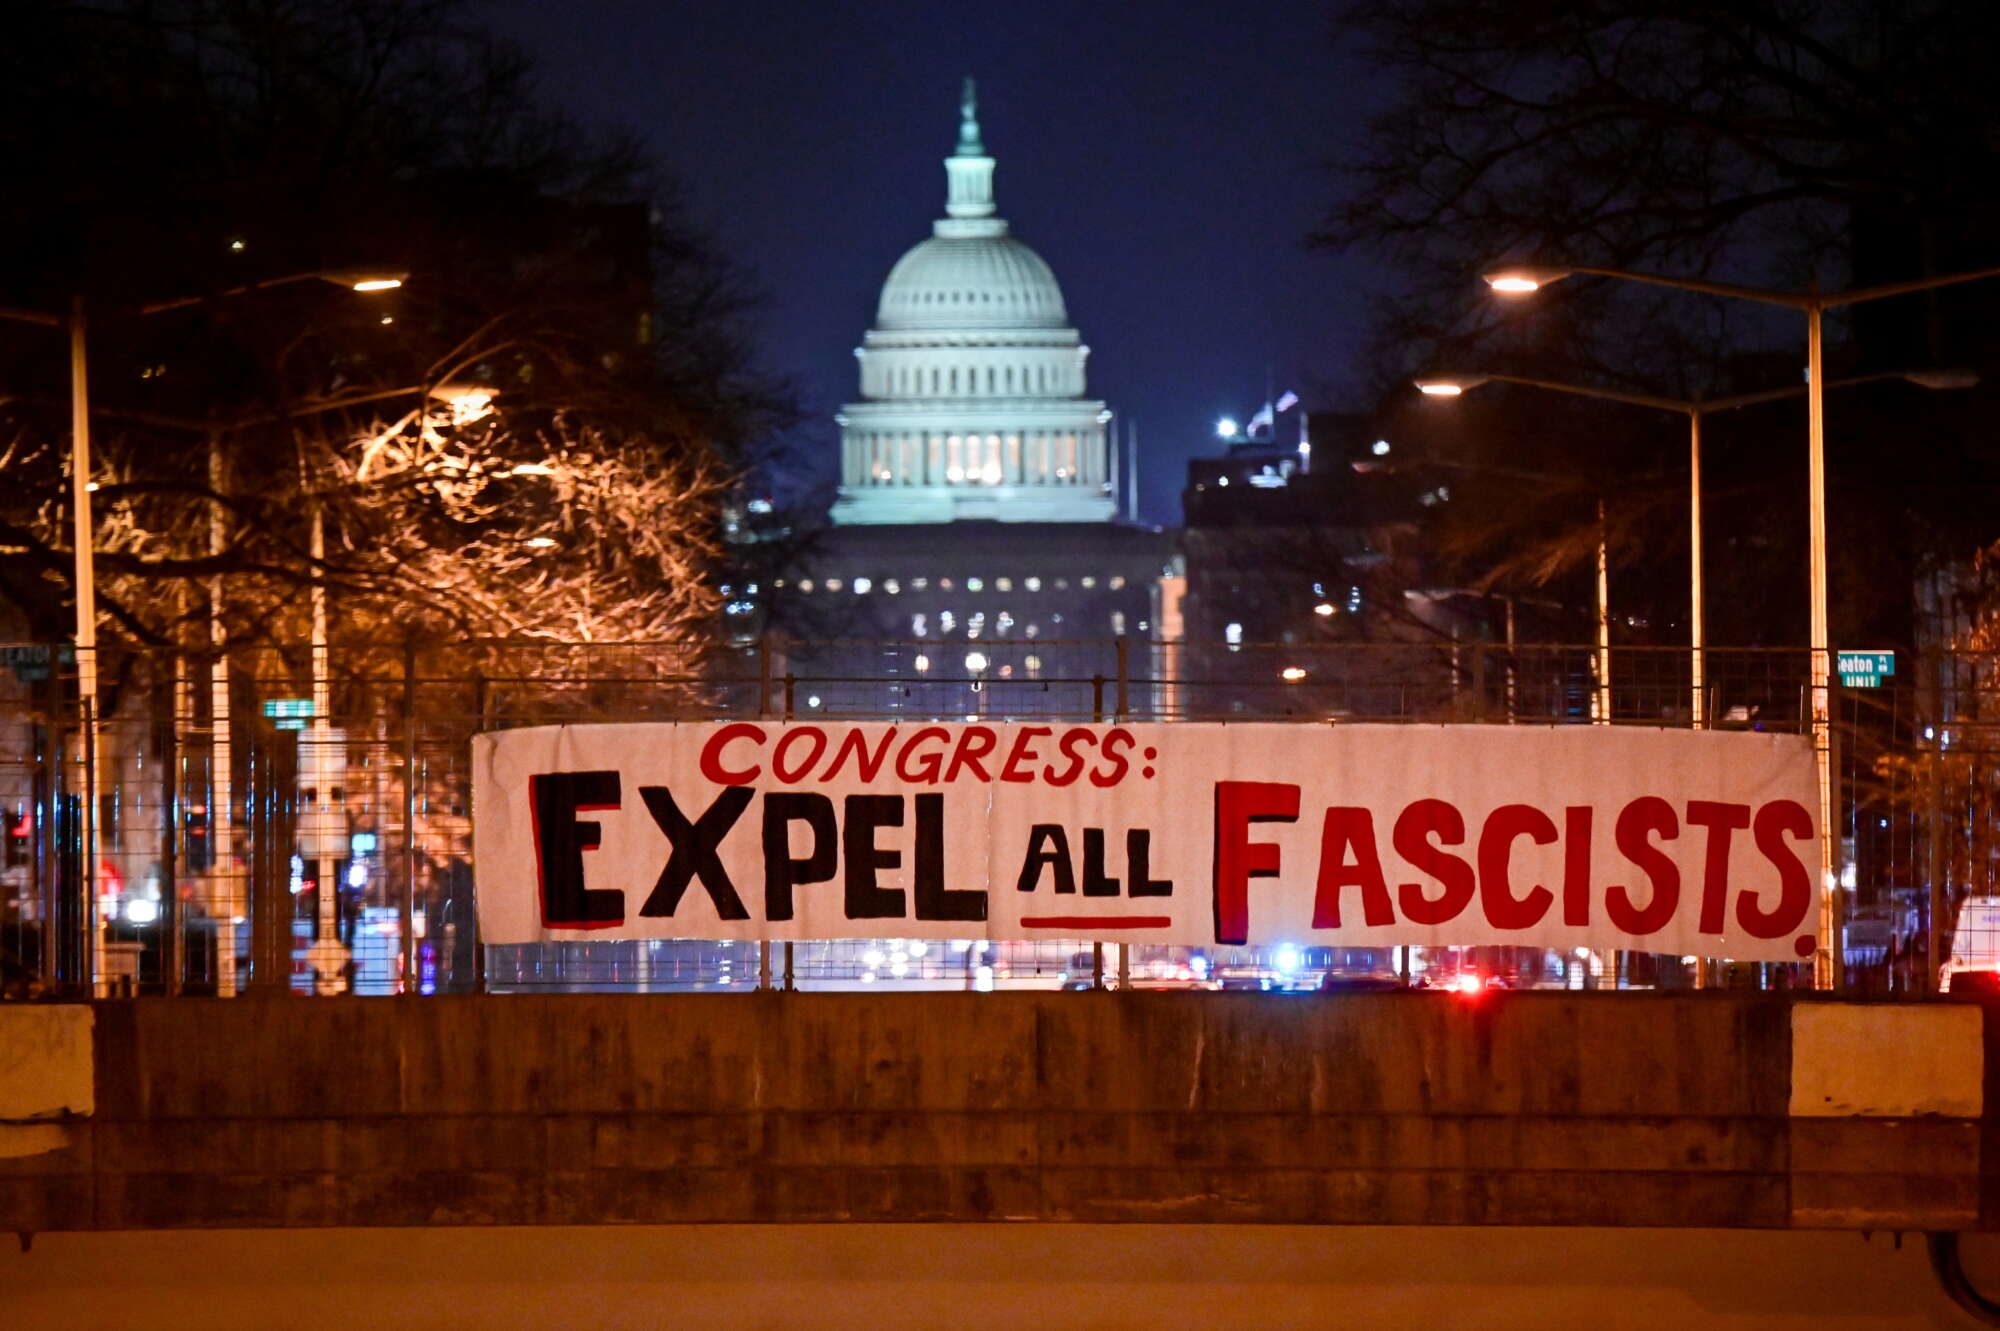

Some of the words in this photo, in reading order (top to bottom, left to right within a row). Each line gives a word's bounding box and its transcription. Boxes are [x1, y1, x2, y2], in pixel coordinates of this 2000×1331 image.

[1846, 675, 1876, 688] UNIT
[700, 723, 1157, 787] CONGRESS:
[528, 770, 988, 929] EXPEL
[1016, 823, 1173, 898] ALL
[1213, 780, 1818, 957] FASCISTS.
